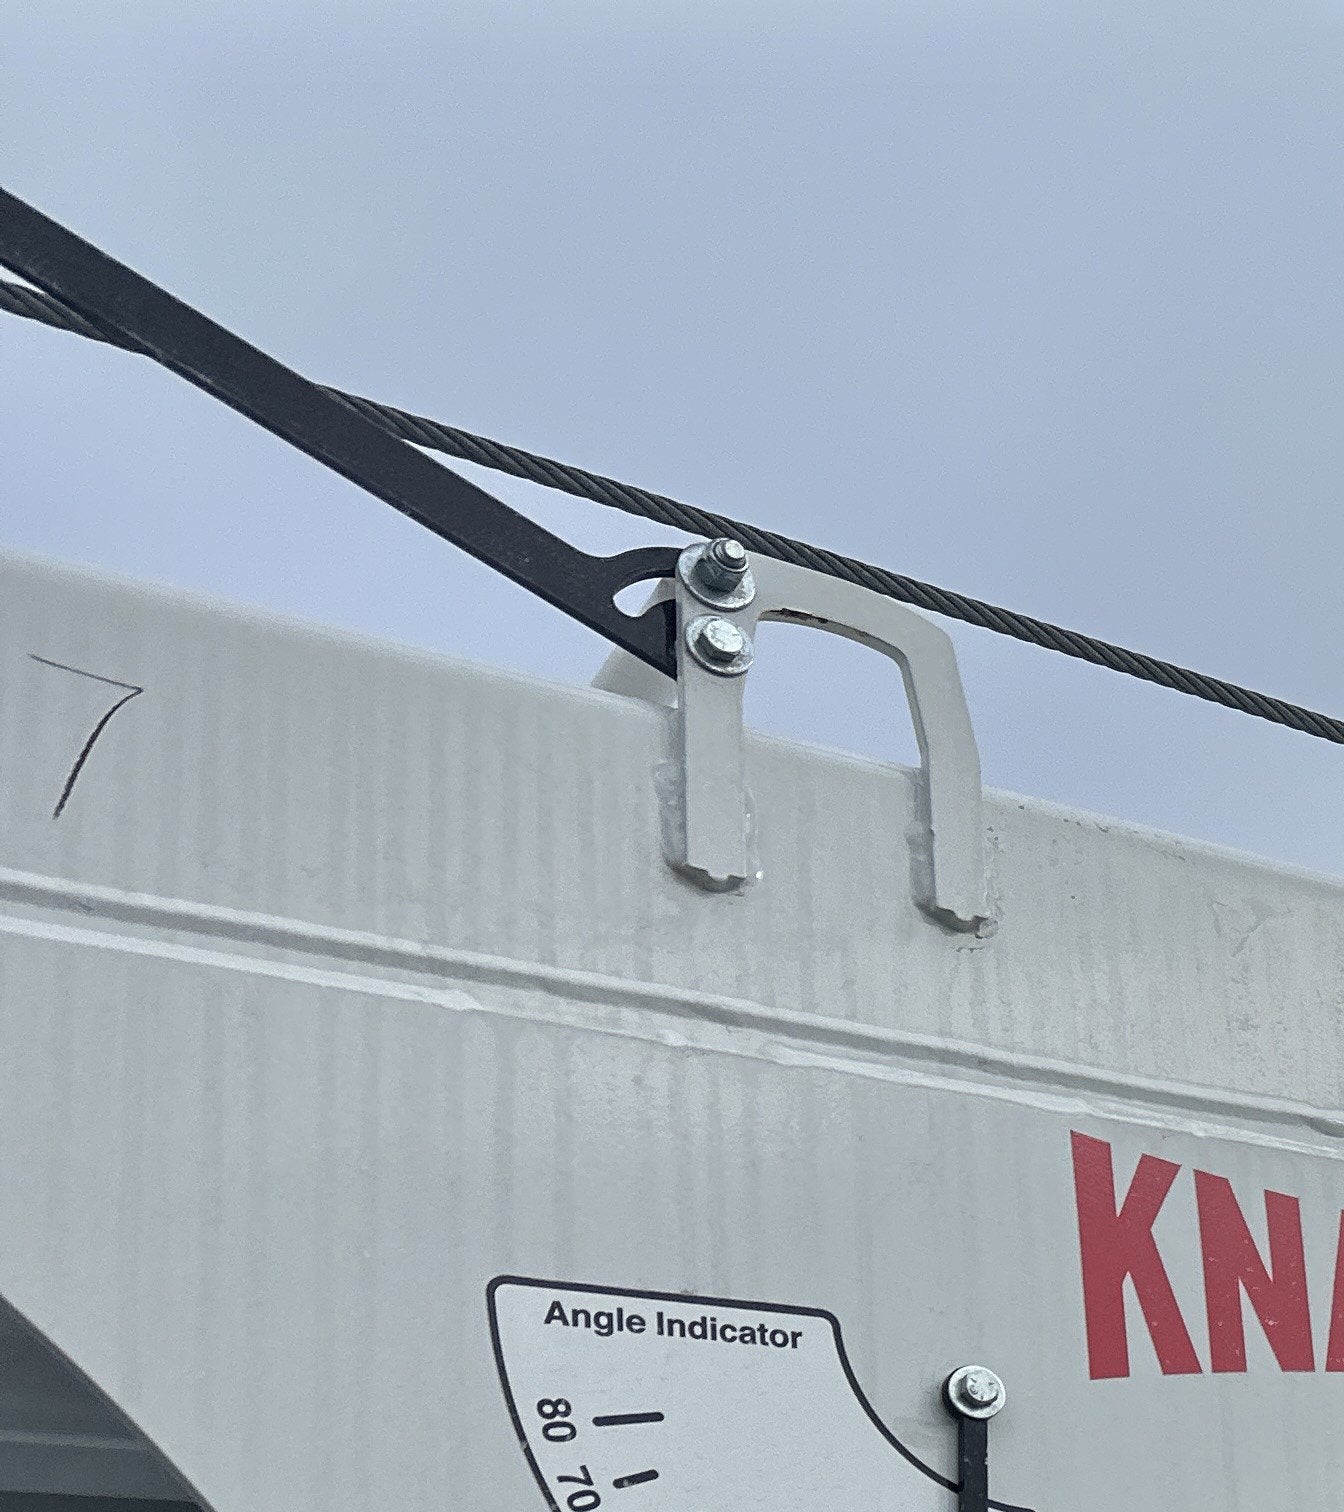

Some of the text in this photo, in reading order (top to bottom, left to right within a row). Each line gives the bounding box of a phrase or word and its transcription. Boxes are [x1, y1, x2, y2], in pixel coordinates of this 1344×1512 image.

[28, 653, 143, 820] 7
[544, 1299, 804, 1350] Angle Indicator
[537, 1398, 577, 1442] 80
[557, 1465, 601, 1512] 70
